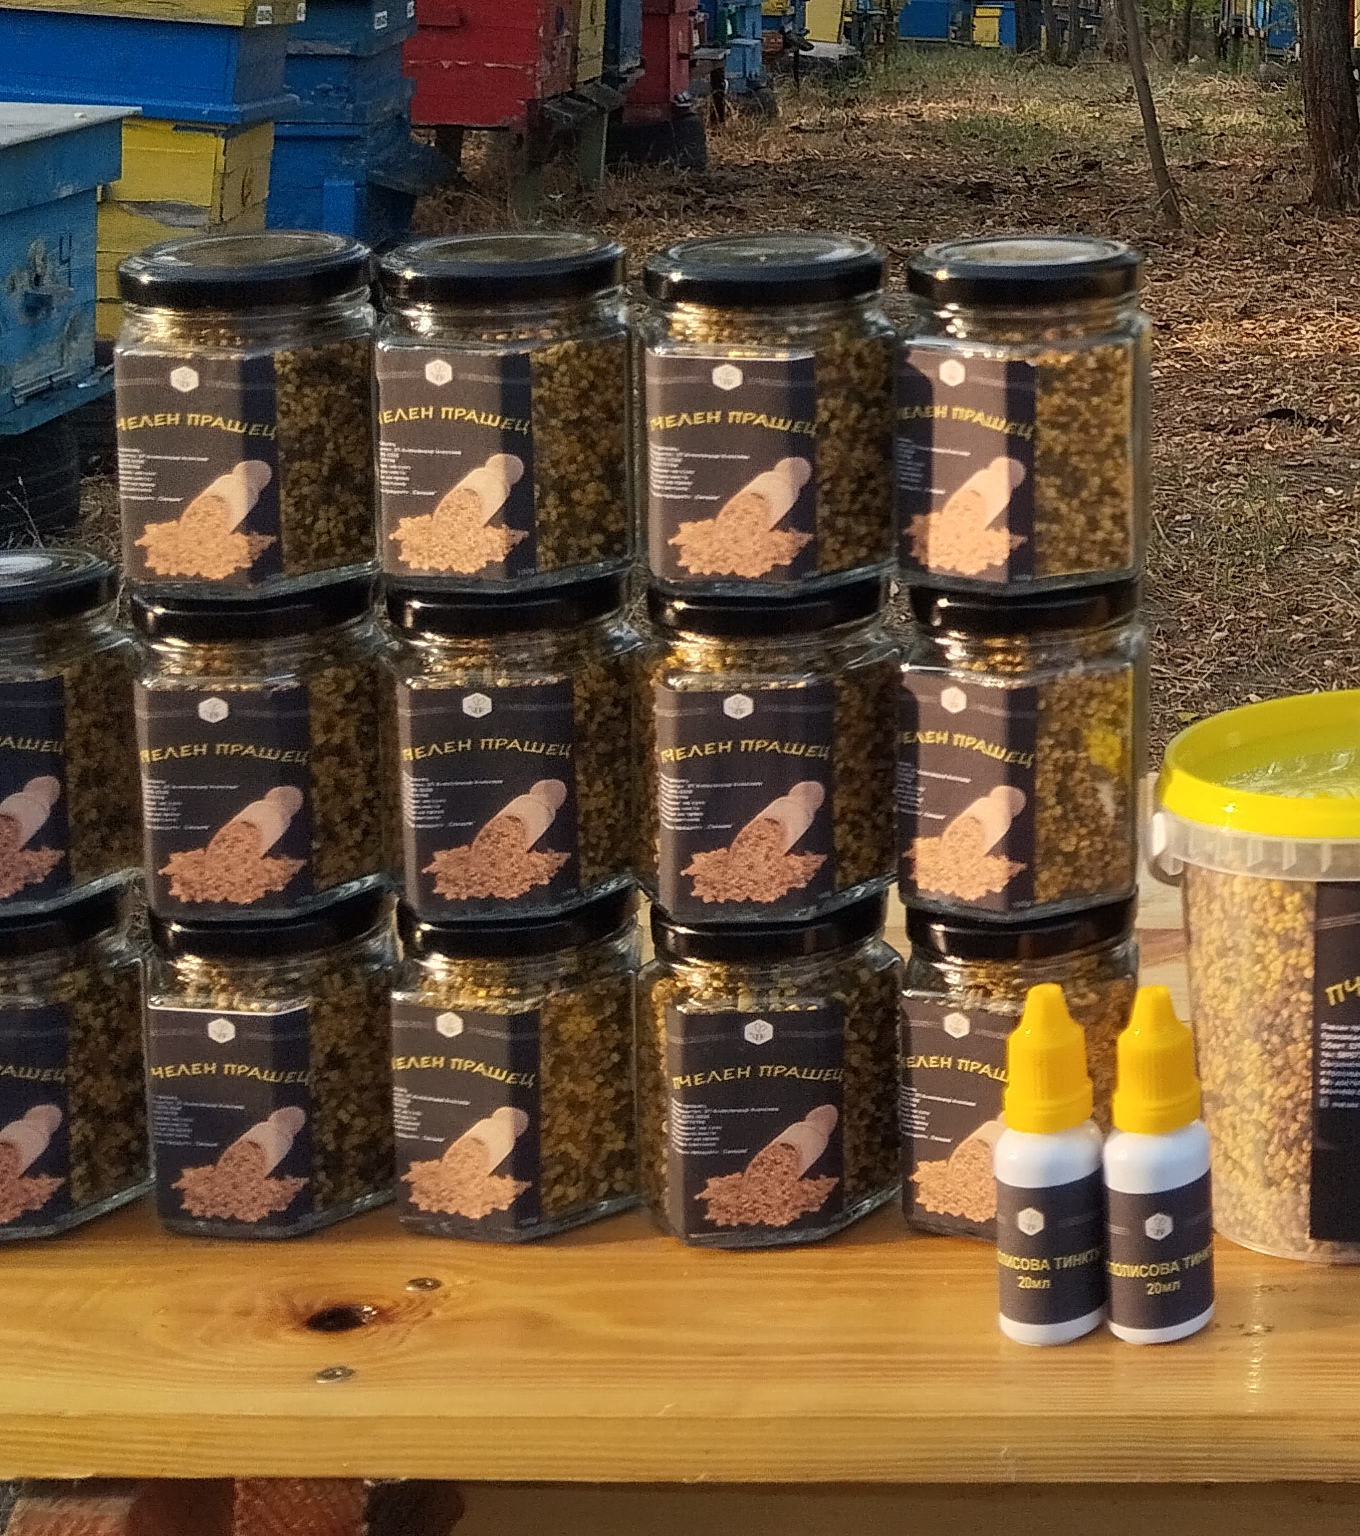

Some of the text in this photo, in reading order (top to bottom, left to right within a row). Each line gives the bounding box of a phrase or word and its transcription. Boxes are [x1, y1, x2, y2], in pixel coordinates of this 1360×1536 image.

[187, 414, 277, 440] ПРАШЕЦ
[441, 406, 530, 436] ПРАШЕЦ
[728, 411, 818, 438] ПРАШЕЦ
[215, 743, 309, 764] ПРАШЕЦ
[480, 738, 571, 759] ПРАШЕЦ
[740, 739, 830, 760] ПРАШЕЦ
[953, 734, 1034, 768] ПРАШЕЦ
[224, 1063, 310, 1086] ПРАШЕЦ
[450, 1057, 536, 1089] ПРАШЕЦ
[759, 1065, 844, 1083] ПРАШЕЦ
